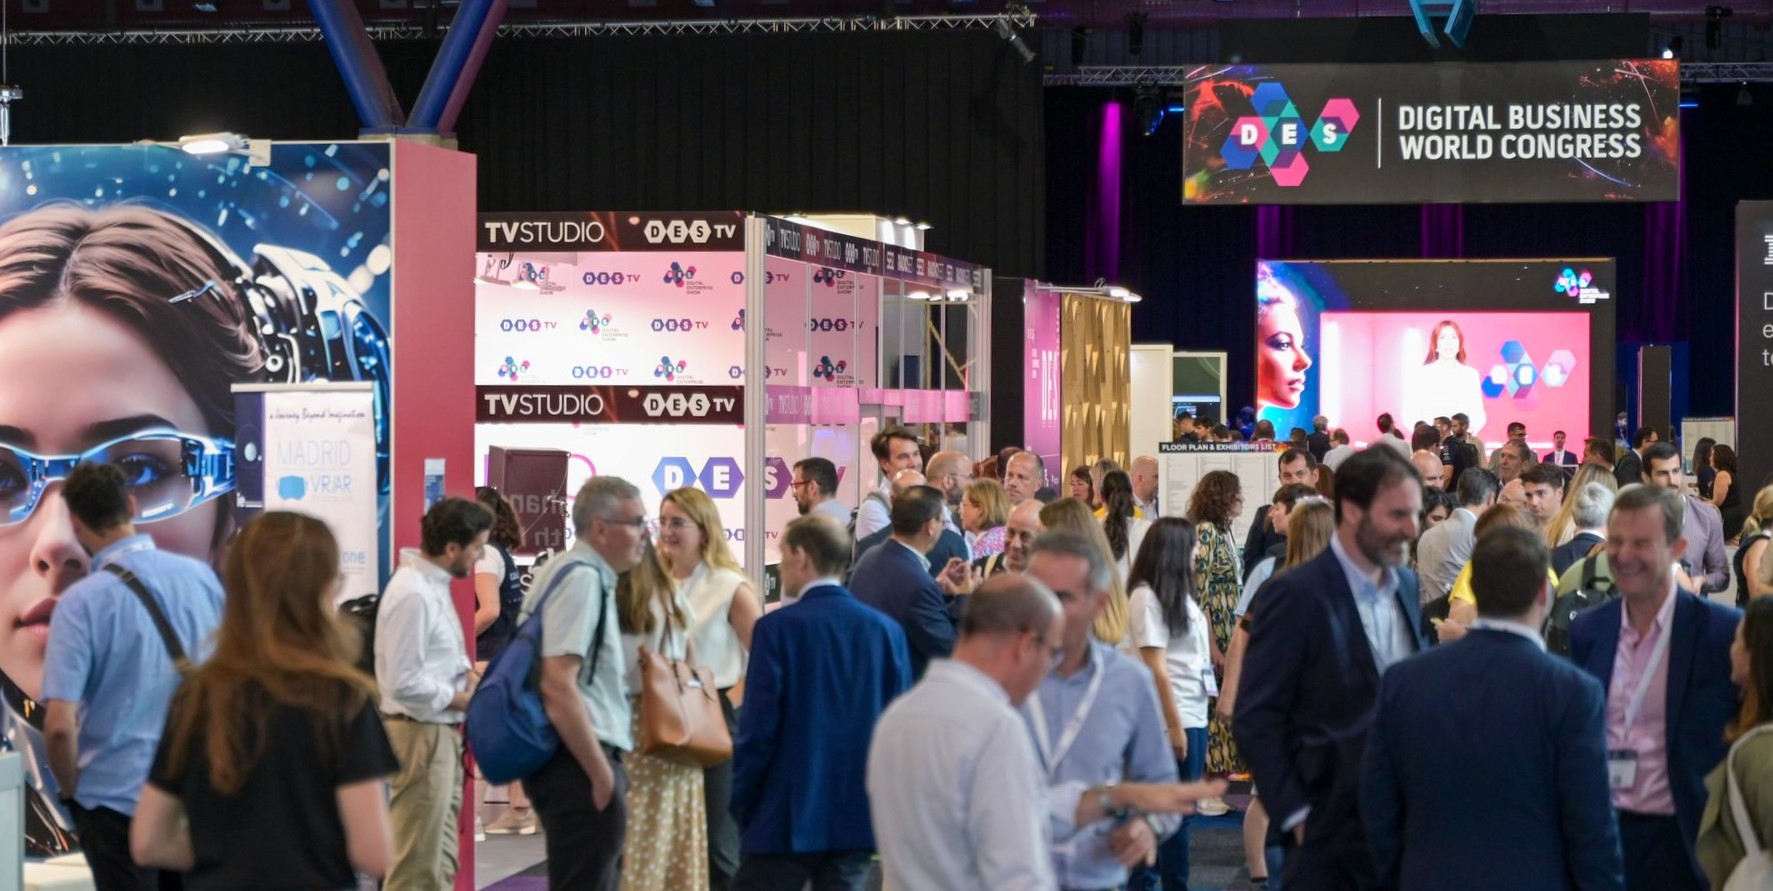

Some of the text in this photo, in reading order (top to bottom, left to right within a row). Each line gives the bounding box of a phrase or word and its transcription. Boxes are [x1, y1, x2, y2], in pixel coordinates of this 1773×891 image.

[1399, 104, 1641, 130] DIGITAL BUSINESS
[1241, 123, 1337, 145] DES
[1400, 133, 1642, 160] WORLD CONGRESS
[649, 223, 706, 240] DES
[713, 224, 737, 239] TV
[626, 274, 640, 282] TV
[776, 274, 790, 282] TV
[544, 321, 557, 329] TV
[695, 321, 708, 329] TV
[774, 368, 787, 376] TV
[648, 397, 705, 413] DES
[712, 398, 735, 412] TV
[277, 440, 351, 466] MADRID
[1216, 443, 1260, 451] EXHIBITORS
